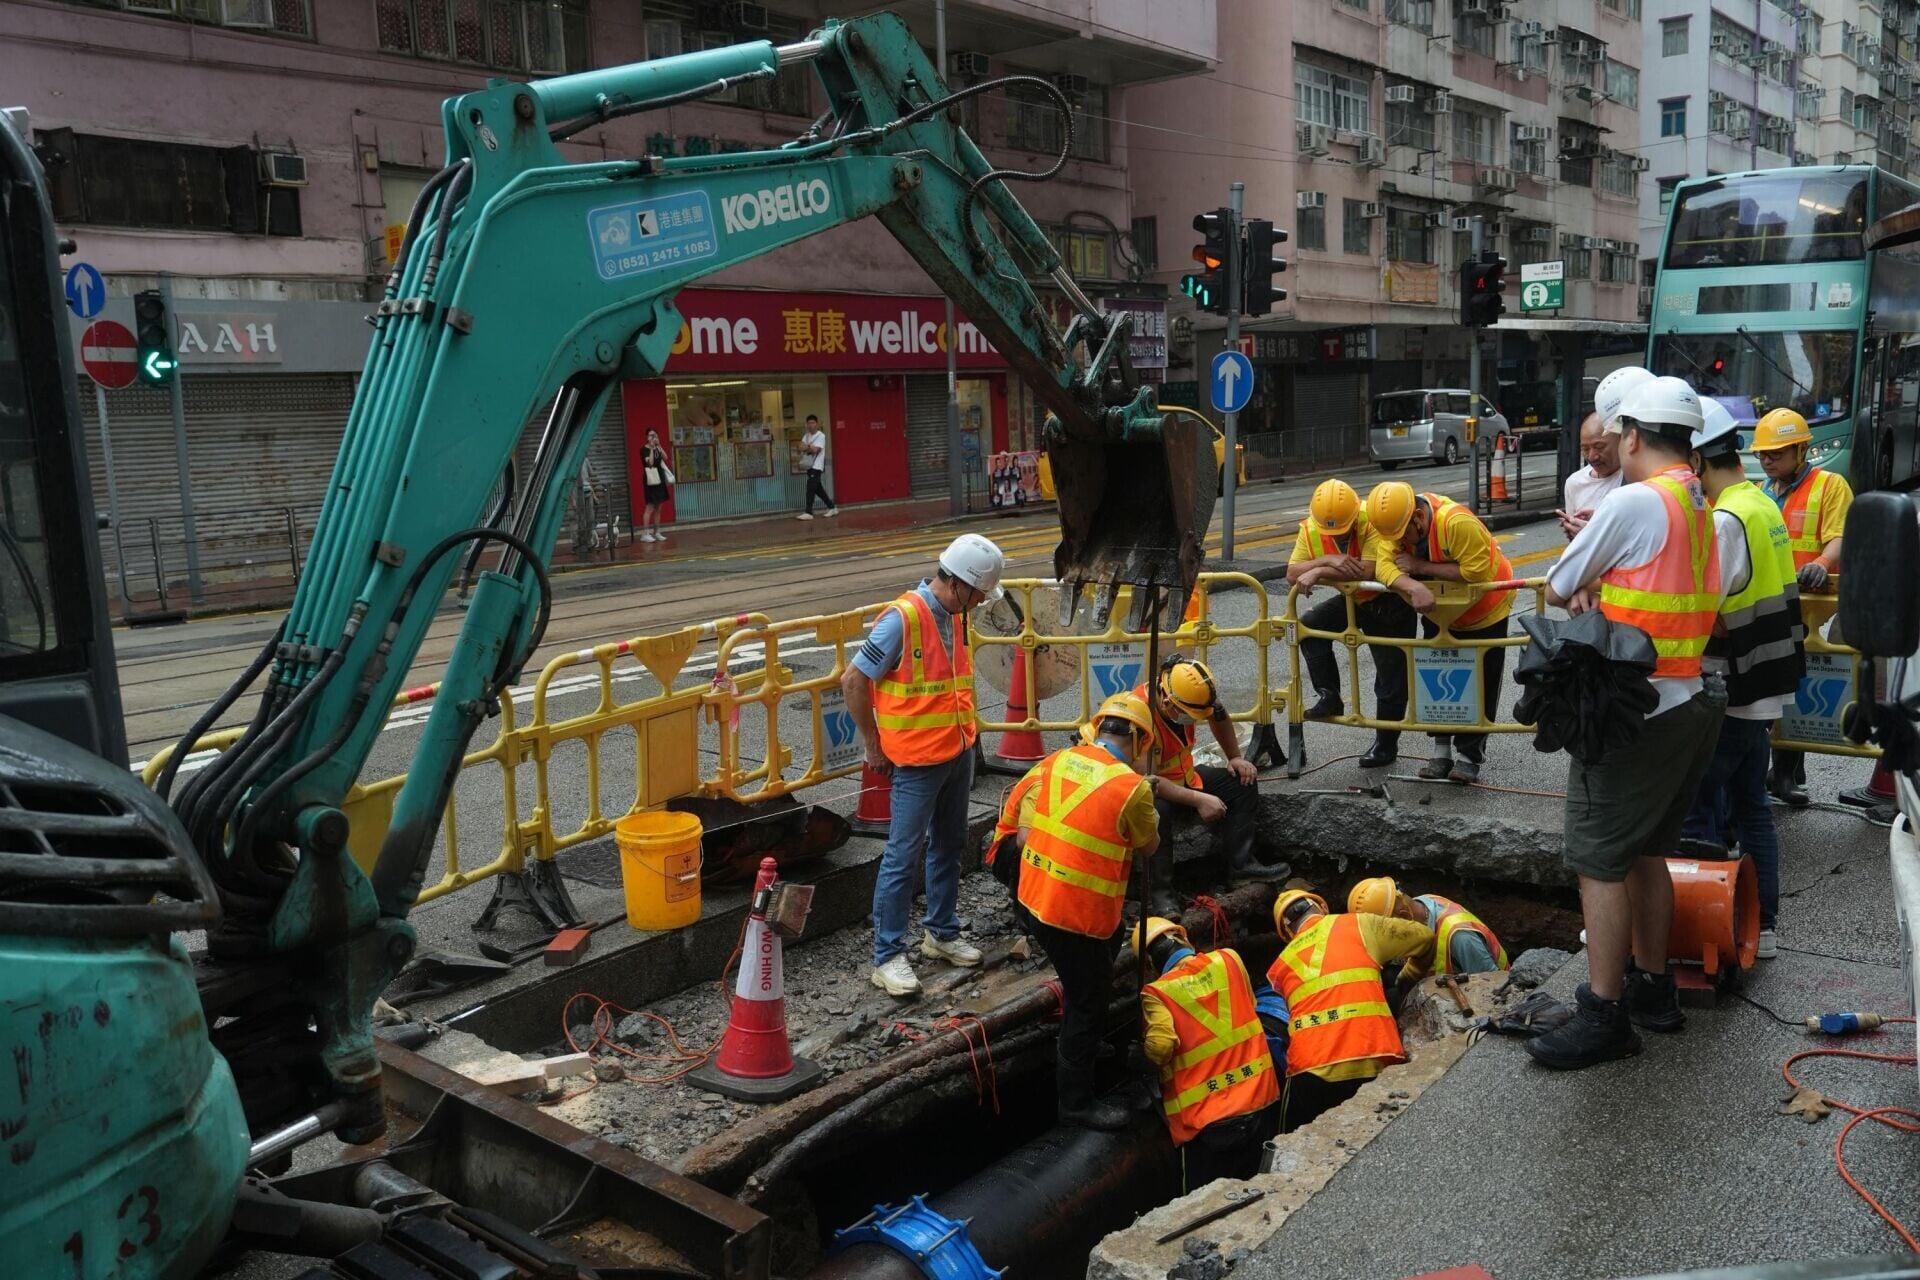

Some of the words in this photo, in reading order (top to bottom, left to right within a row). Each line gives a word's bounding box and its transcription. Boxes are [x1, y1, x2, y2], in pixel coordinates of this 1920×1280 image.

[720, 178, 831, 235] KOBELCO
[618, 255, 650, 273] (852)
[653, 248, 681, 263] 2475
[684, 240, 711, 256] 1083
[178, 322, 278, 354] AAH
[782, 307, 847, 354] 惠康
[850, 310, 999, 354] wellcom
[1806, 655, 1832, 666] 務署
[761, 957, 773, 992] HING
[1294, 1008, 1358, 1031] 安全第一
